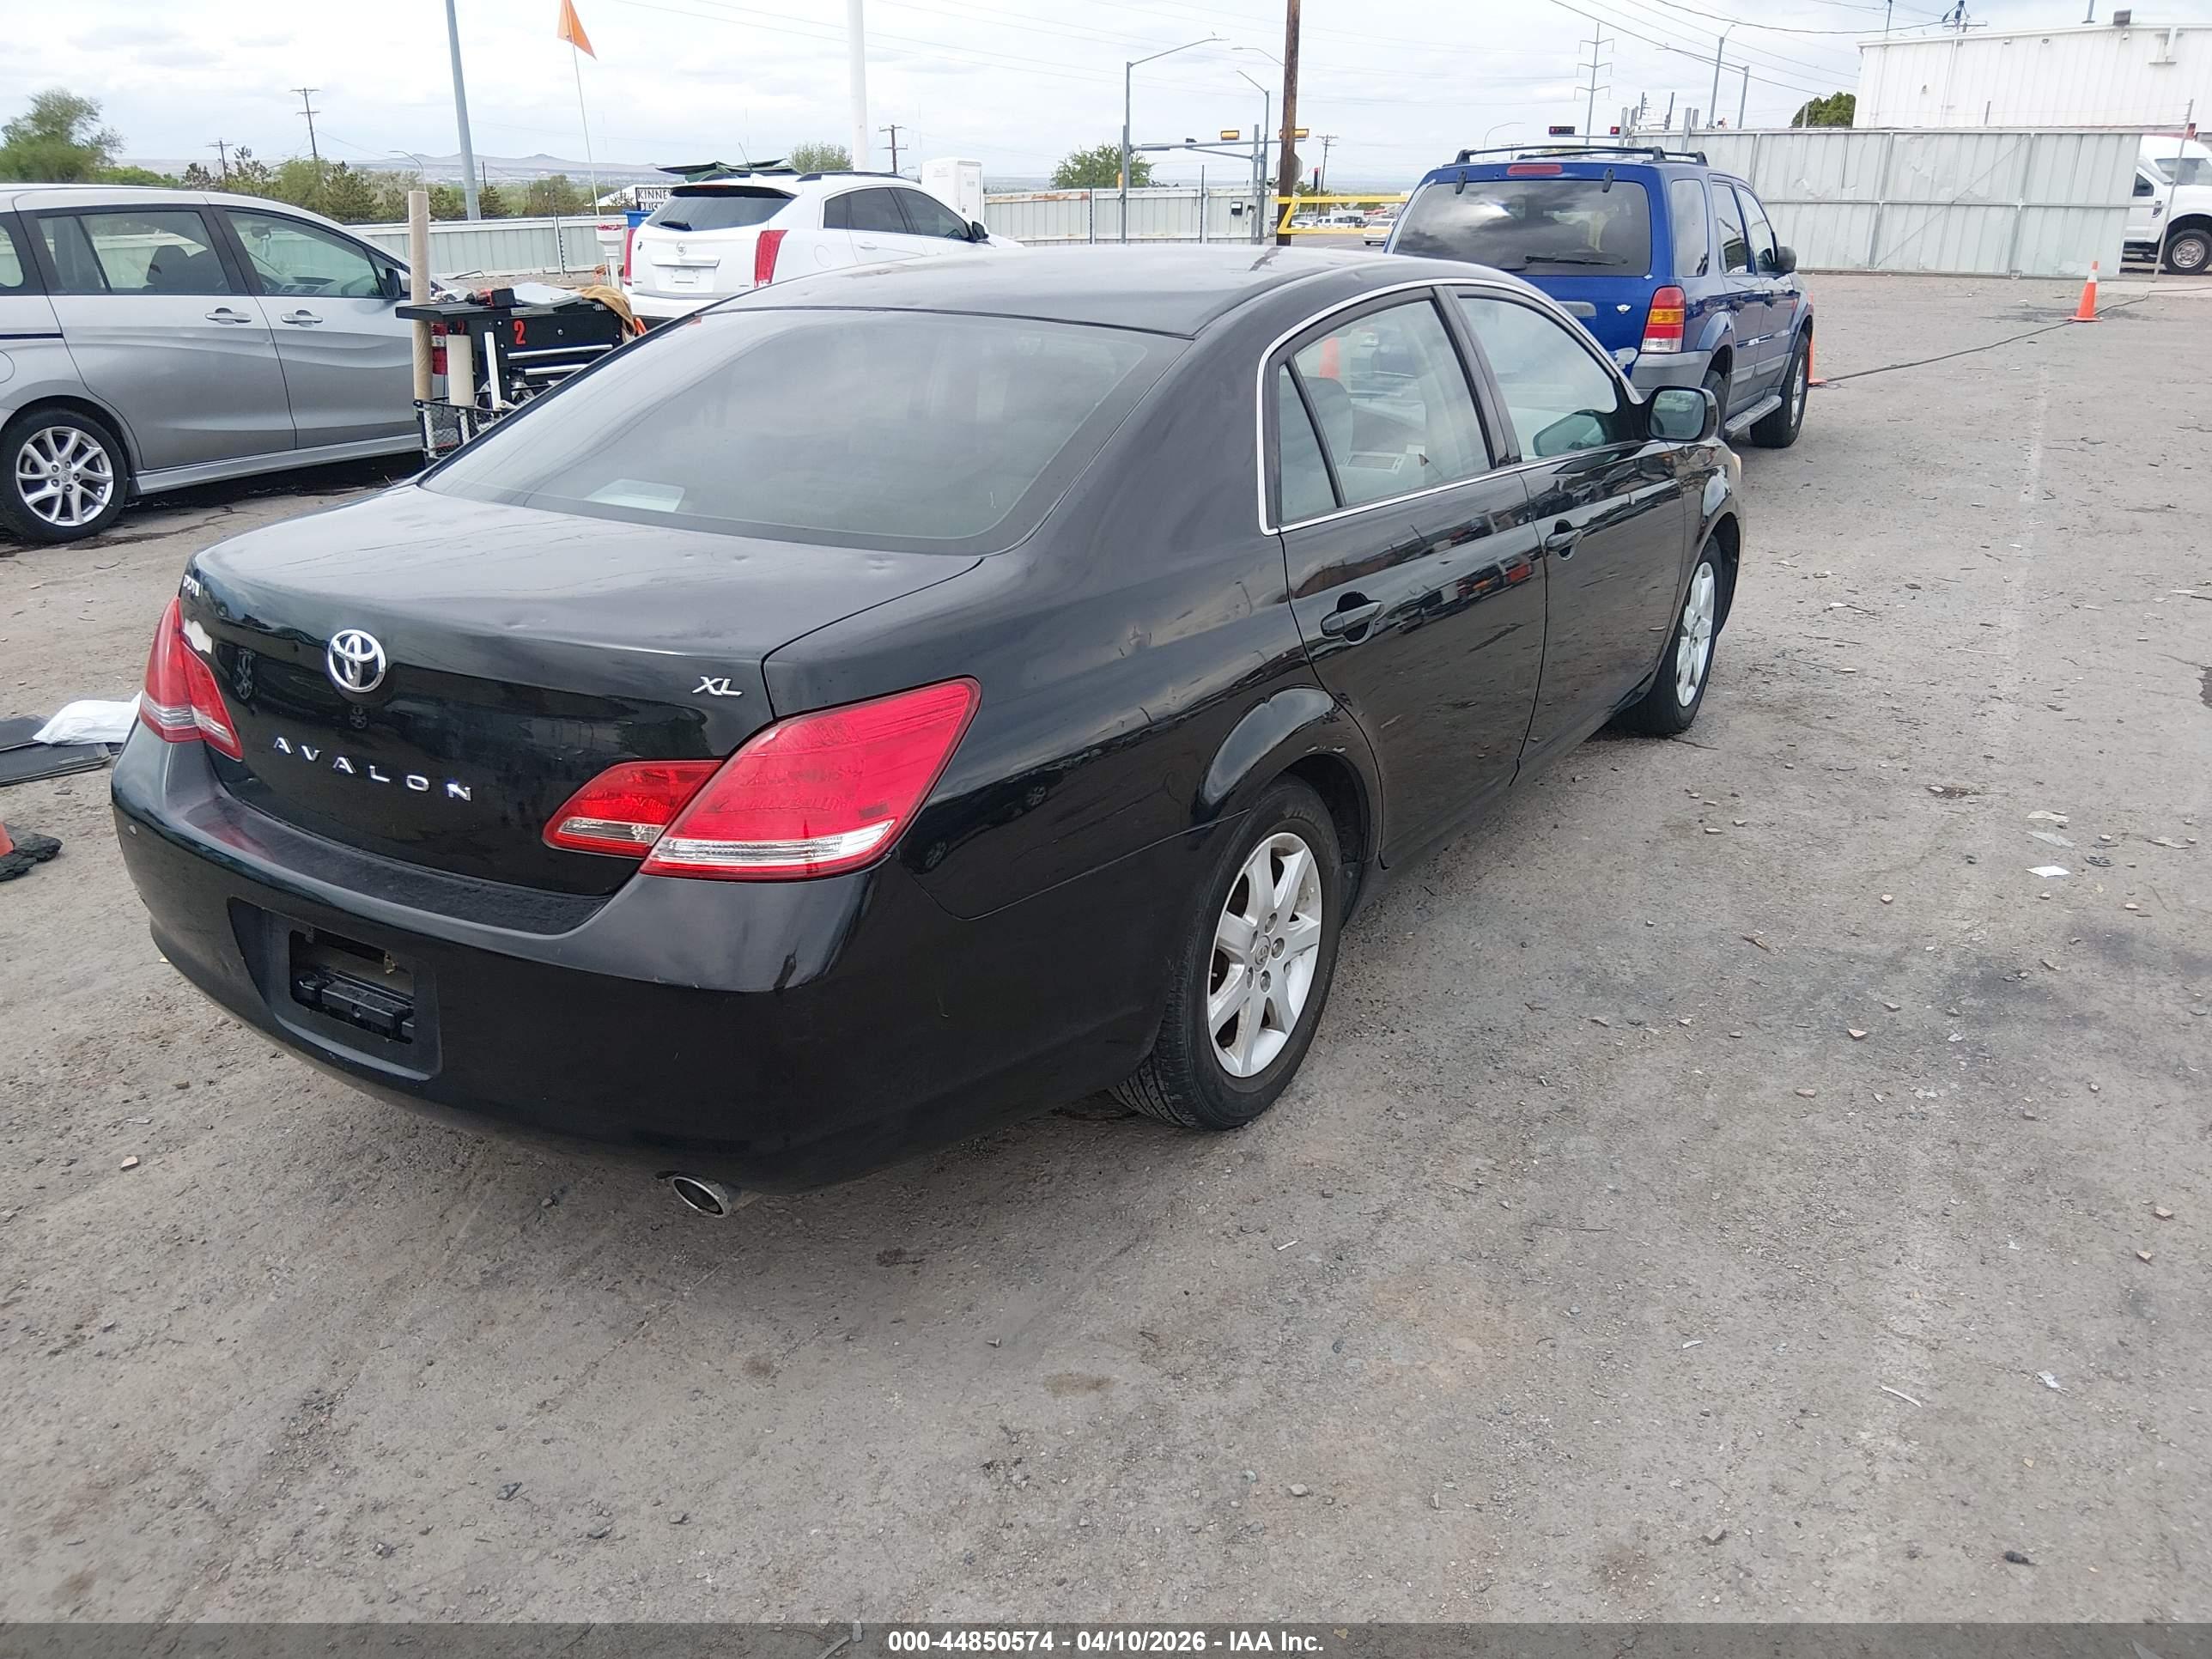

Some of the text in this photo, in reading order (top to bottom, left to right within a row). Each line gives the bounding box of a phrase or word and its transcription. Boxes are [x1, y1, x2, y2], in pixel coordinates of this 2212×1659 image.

[638, 190, 673, 201] KINNEY
[514, 319, 526, 345] 2
[691, 676, 743, 696] XL
[273, 737, 471, 801] AVALON
